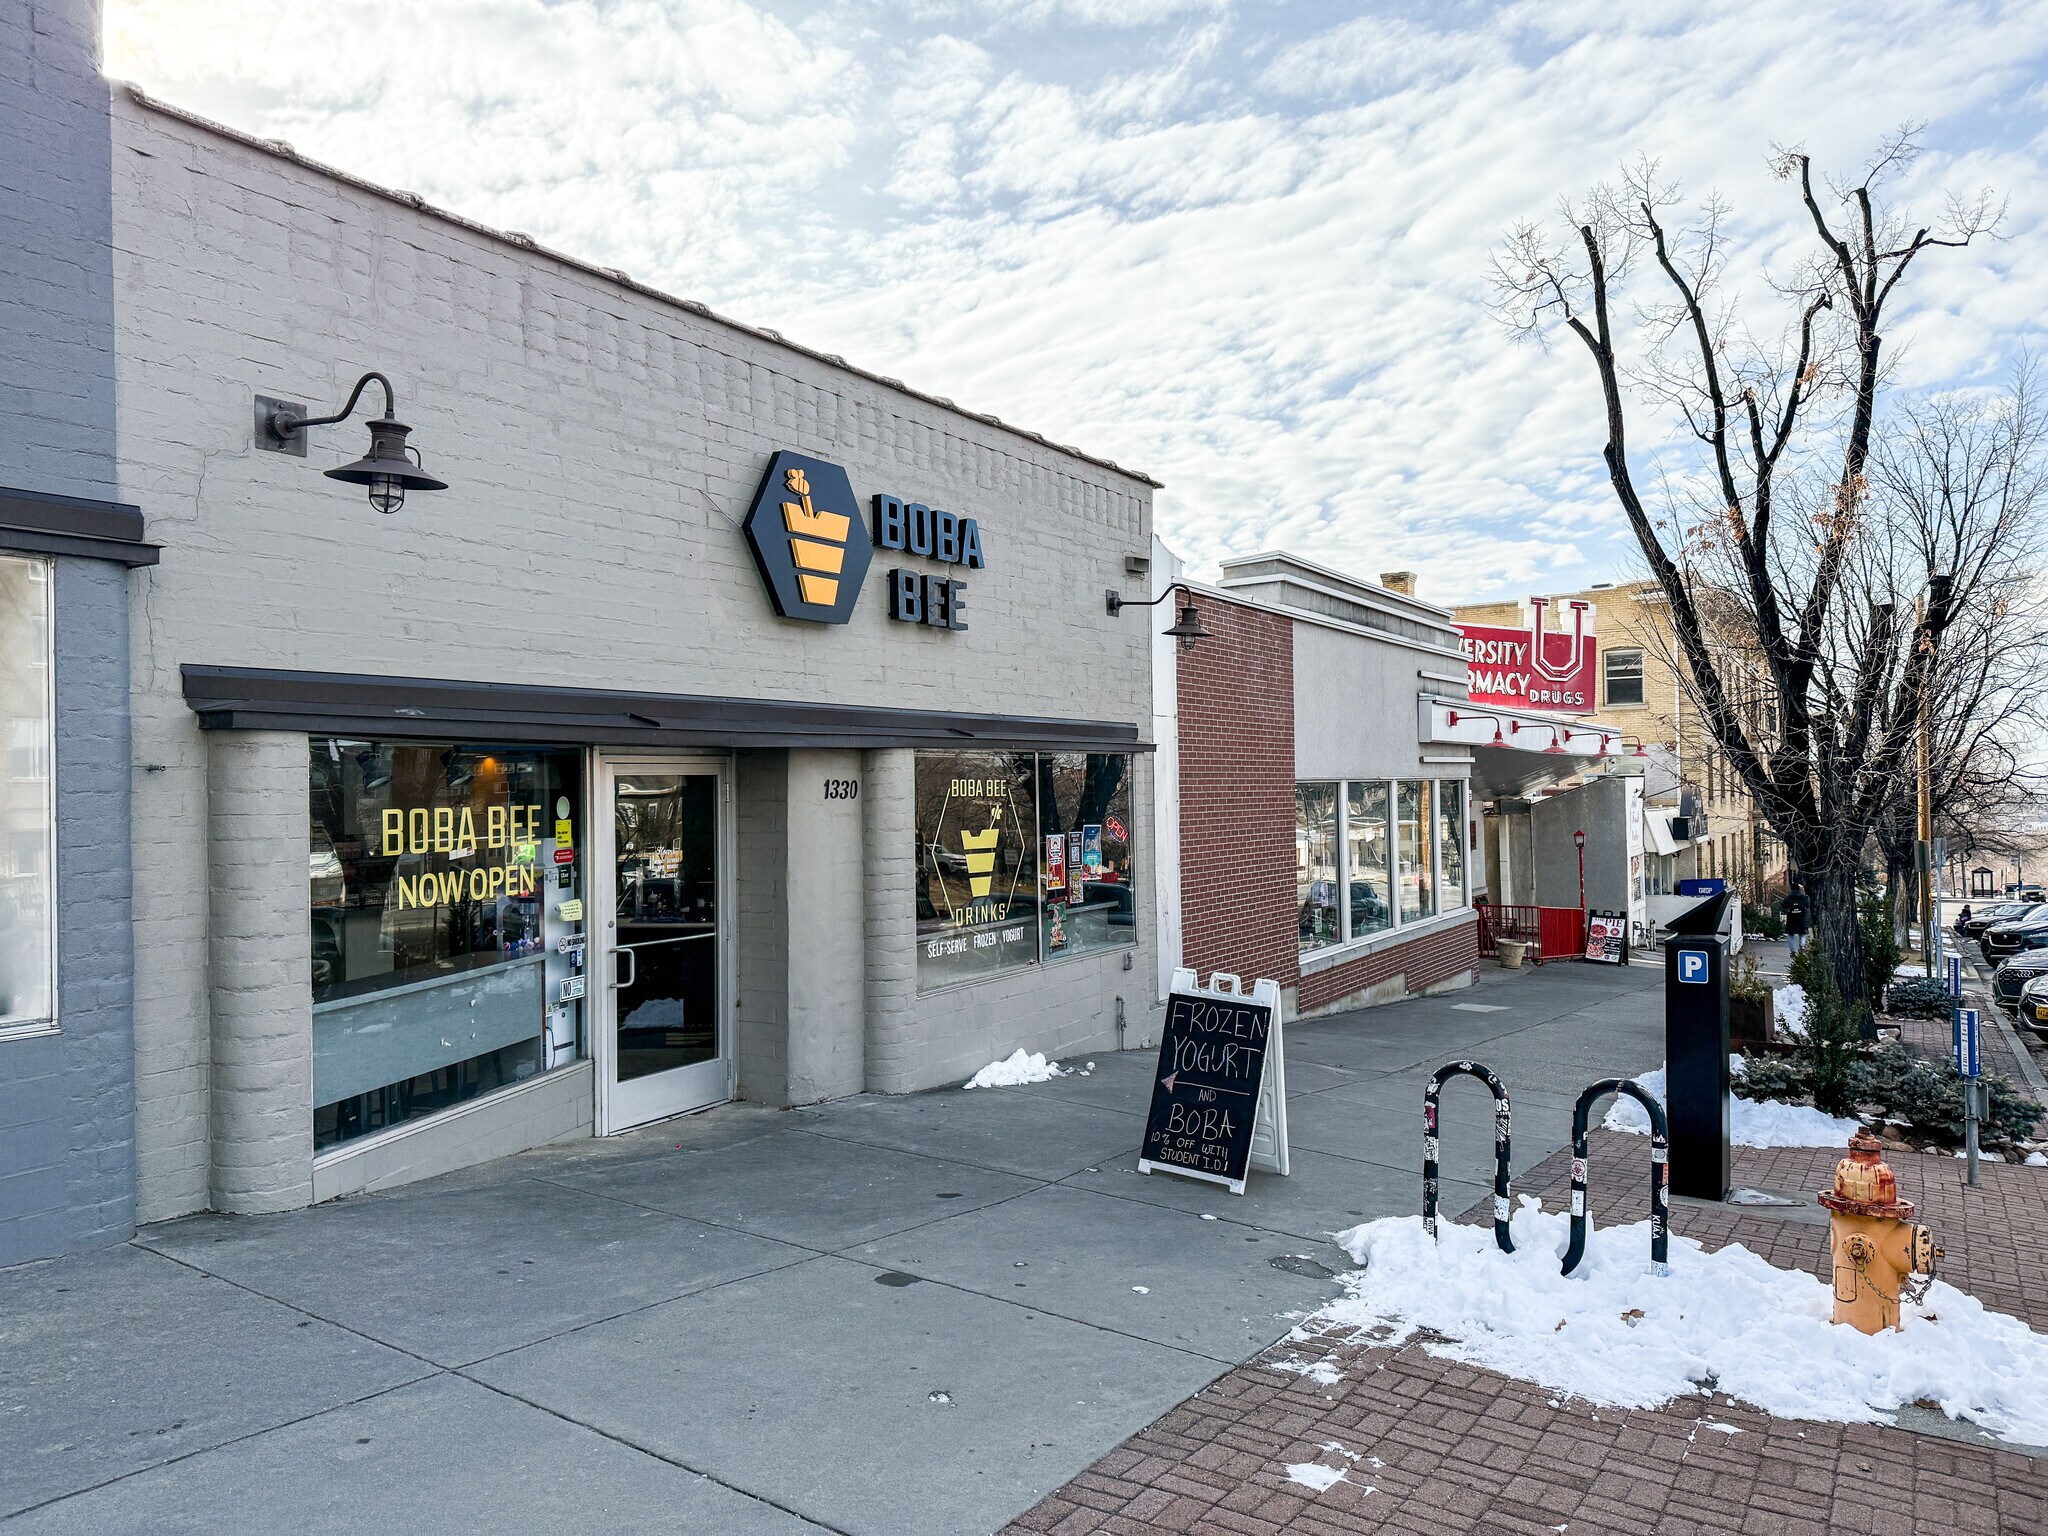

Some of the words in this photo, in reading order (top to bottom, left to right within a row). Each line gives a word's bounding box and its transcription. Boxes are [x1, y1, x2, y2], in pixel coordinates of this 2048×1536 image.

[872, 493, 985, 569] BOBA
[888, 567, 968, 631] BEE
[1467, 669, 1531, 696] RMACY
[1530, 688, 1584, 705] DRUGS
[824, 779, 858, 800] 1330
[951, 779, 983, 797] BOBA
[986, 779, 1007, 797] BEE
[382, 806, 477, 856] BOBA
[488, 804, 542, 849] BEE
[1106, 816, 1128, 842] OPEN
[399, 870, 465, 910] NOW
[469, 863, 535, 901] OPEN
[955, 903, 1006, 927] DRINKS
[1605, 917, 1622, 928] PIE
[927, 938, 968, 959] SELF-SERVE
[973, 932, 997, 949] FROZEN
[1002, 926, 1024, 943] YOGURT
[1685, 955, 1702, 977] P
[563, 981, 572, 997] NO
[1171, 1001, 1268, 1041] FROZEN
[1173, 1035, 1264, 1079] YOGURT
[1198, 1088, 1217, 1103] AND
[1165, 1102, 1236, 1141] BOBA
[1177, 1137, 1196, 1150] OFF
[1160, 1147, 1201, 1166] STUDENT
